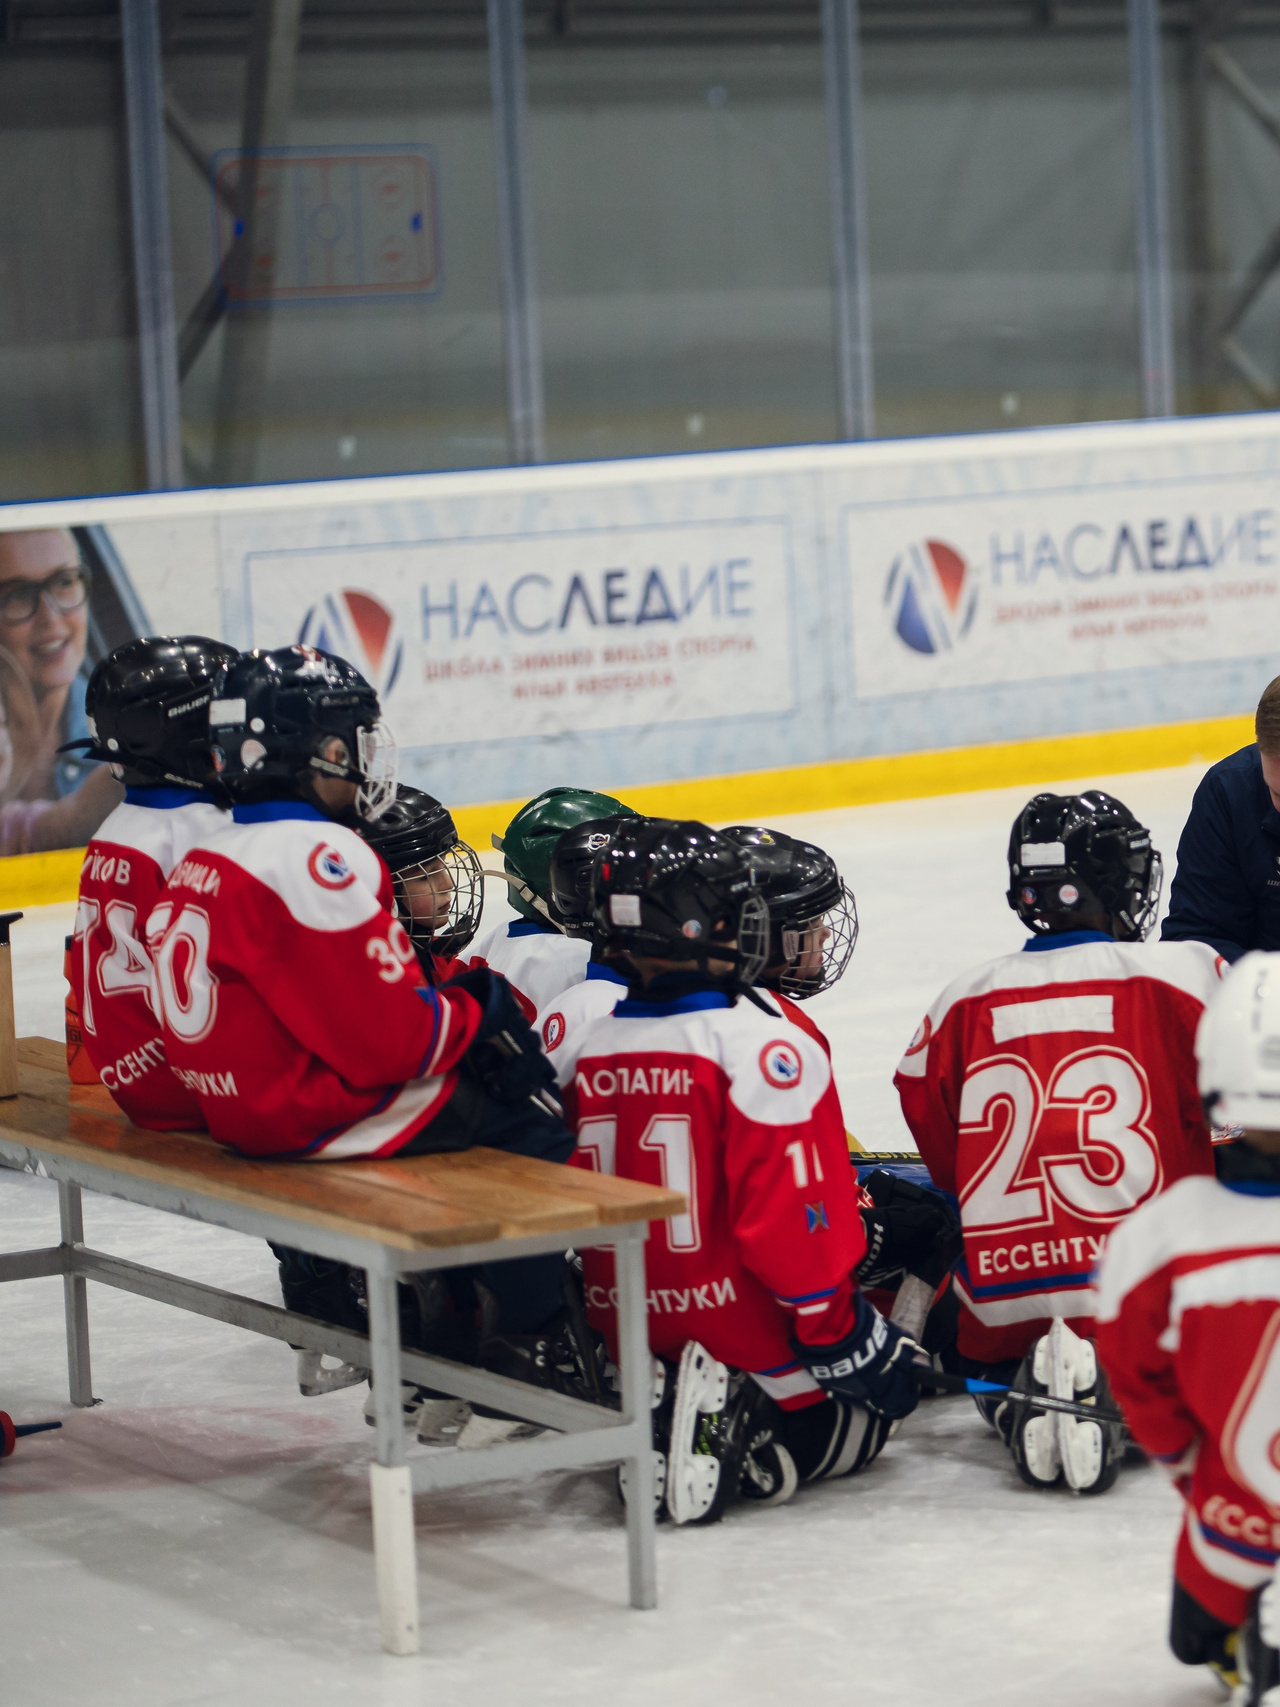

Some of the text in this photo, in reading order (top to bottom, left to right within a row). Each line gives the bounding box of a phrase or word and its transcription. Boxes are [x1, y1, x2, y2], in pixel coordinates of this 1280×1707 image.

[990, 509, 1277, 585] НАСЛЕДИЕ
[420, 557, 754, 641] НАСЛЕДИЕ
[367, 920, 416, 984] 30
[958, 1044, 1164, 1238] 23
